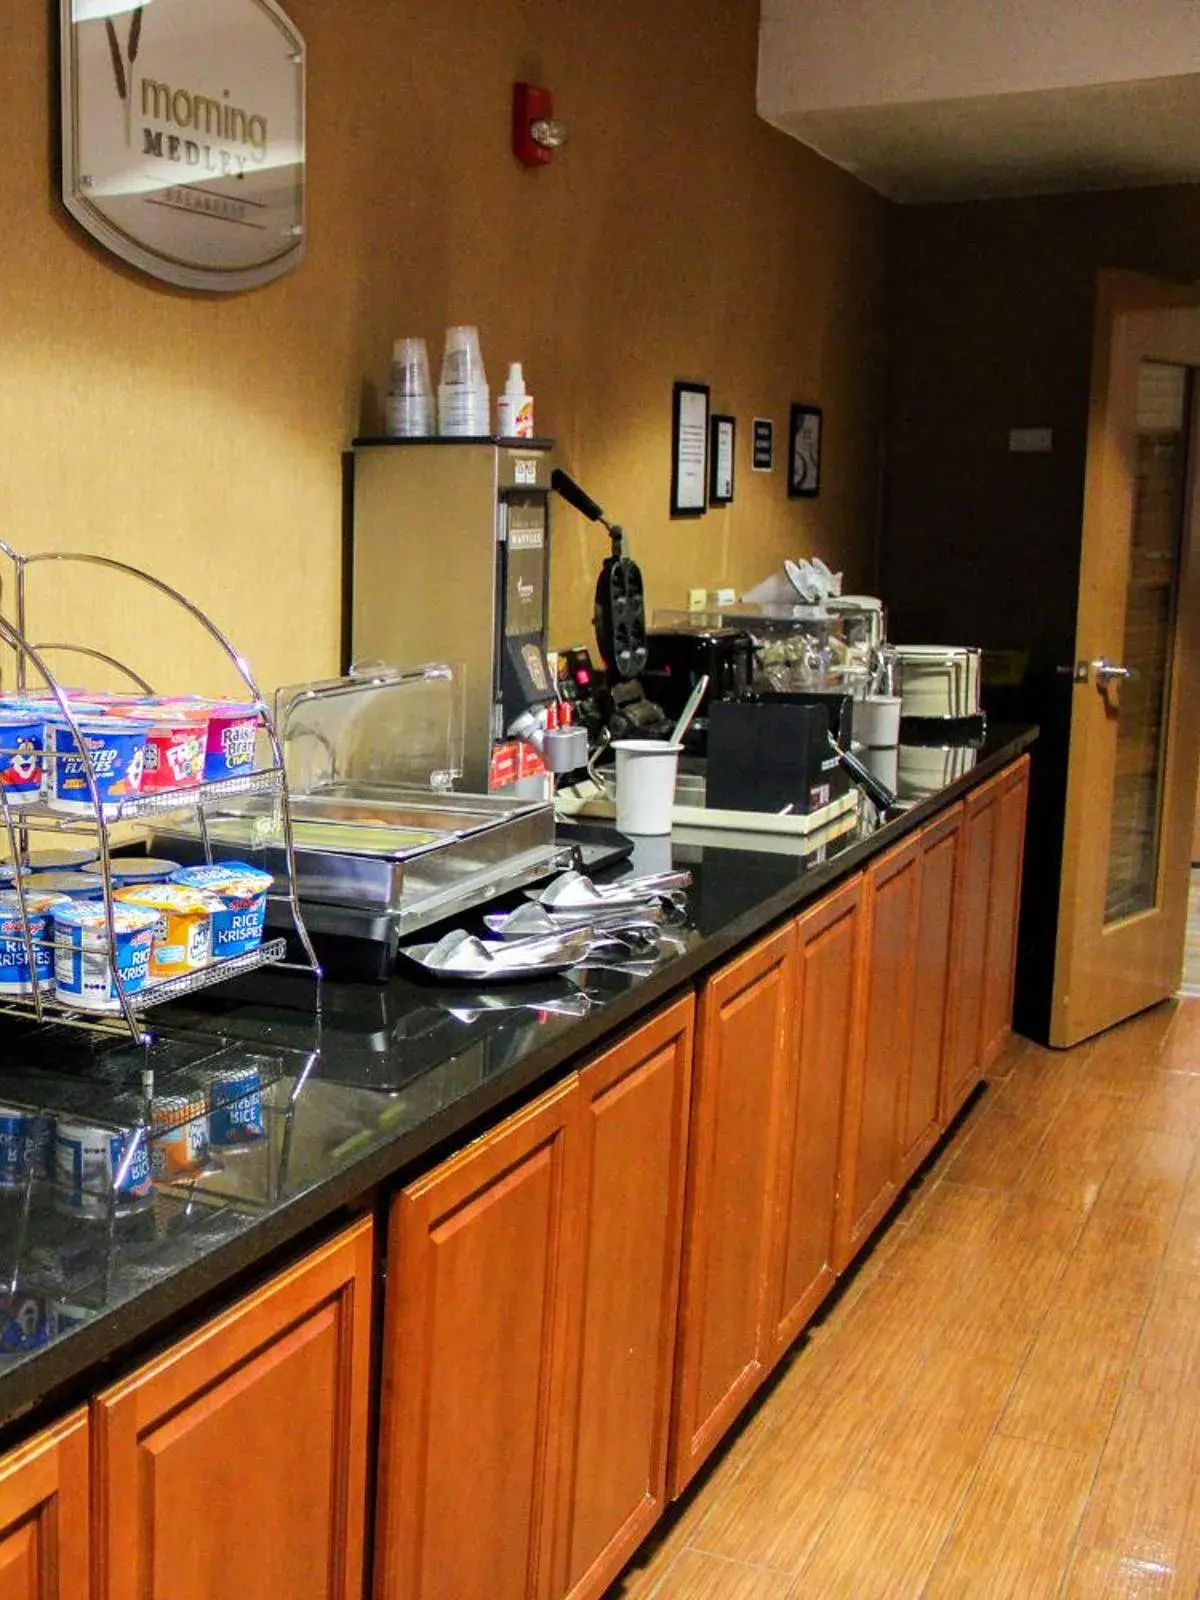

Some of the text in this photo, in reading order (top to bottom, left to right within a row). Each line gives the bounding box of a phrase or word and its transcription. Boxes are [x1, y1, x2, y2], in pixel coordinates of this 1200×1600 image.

[141, 78, 267, 163] morning
[143, 127, 247, 179] MEDLEY
[232, 913, 259, 929] RICE
